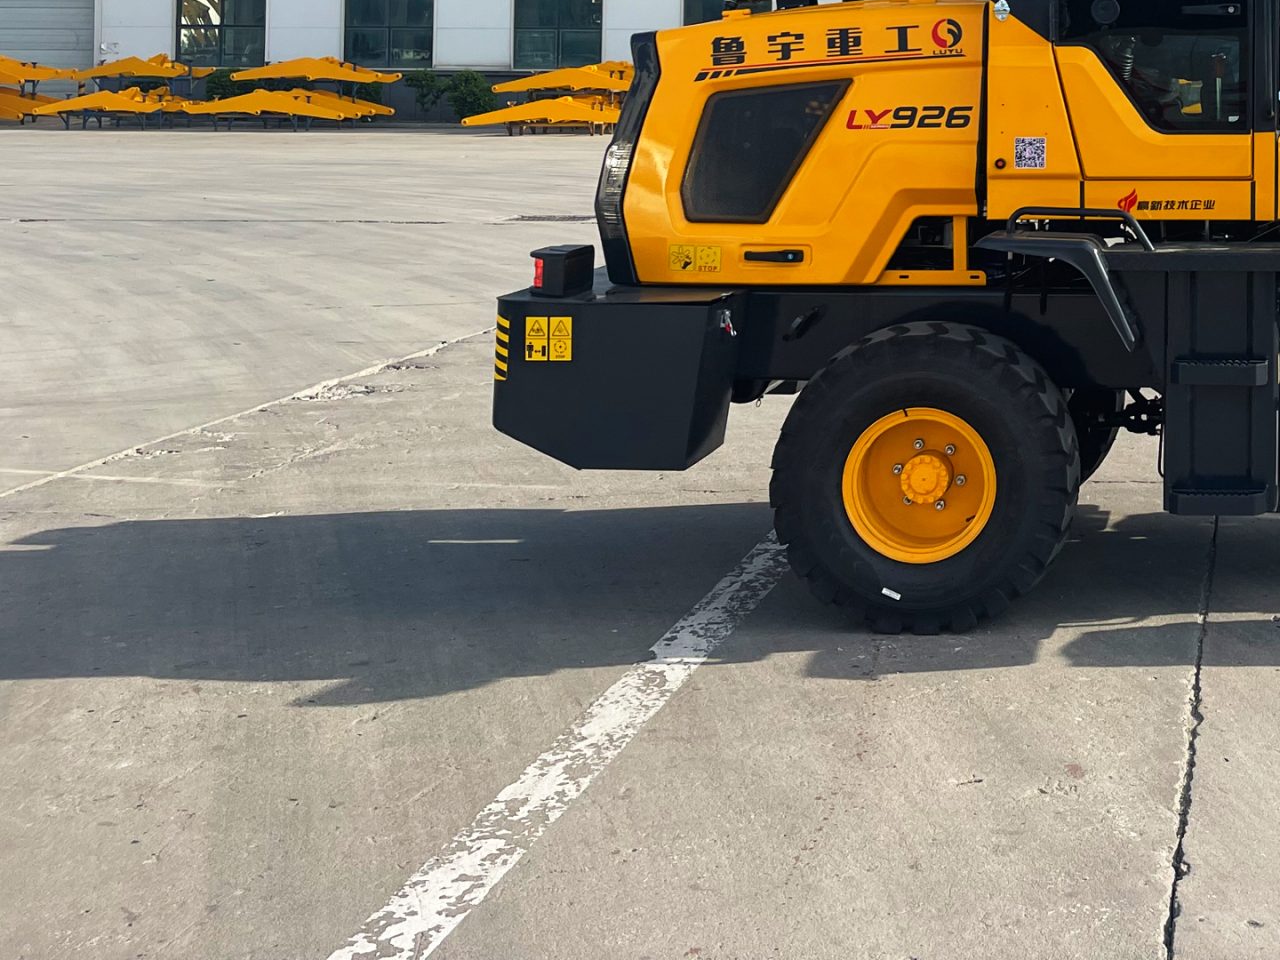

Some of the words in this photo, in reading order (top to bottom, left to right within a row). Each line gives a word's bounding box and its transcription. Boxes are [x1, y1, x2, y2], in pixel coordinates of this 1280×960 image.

[711, 25, 922, 66] 鲁宇重工
[846, 106, 973, 129] LY926
